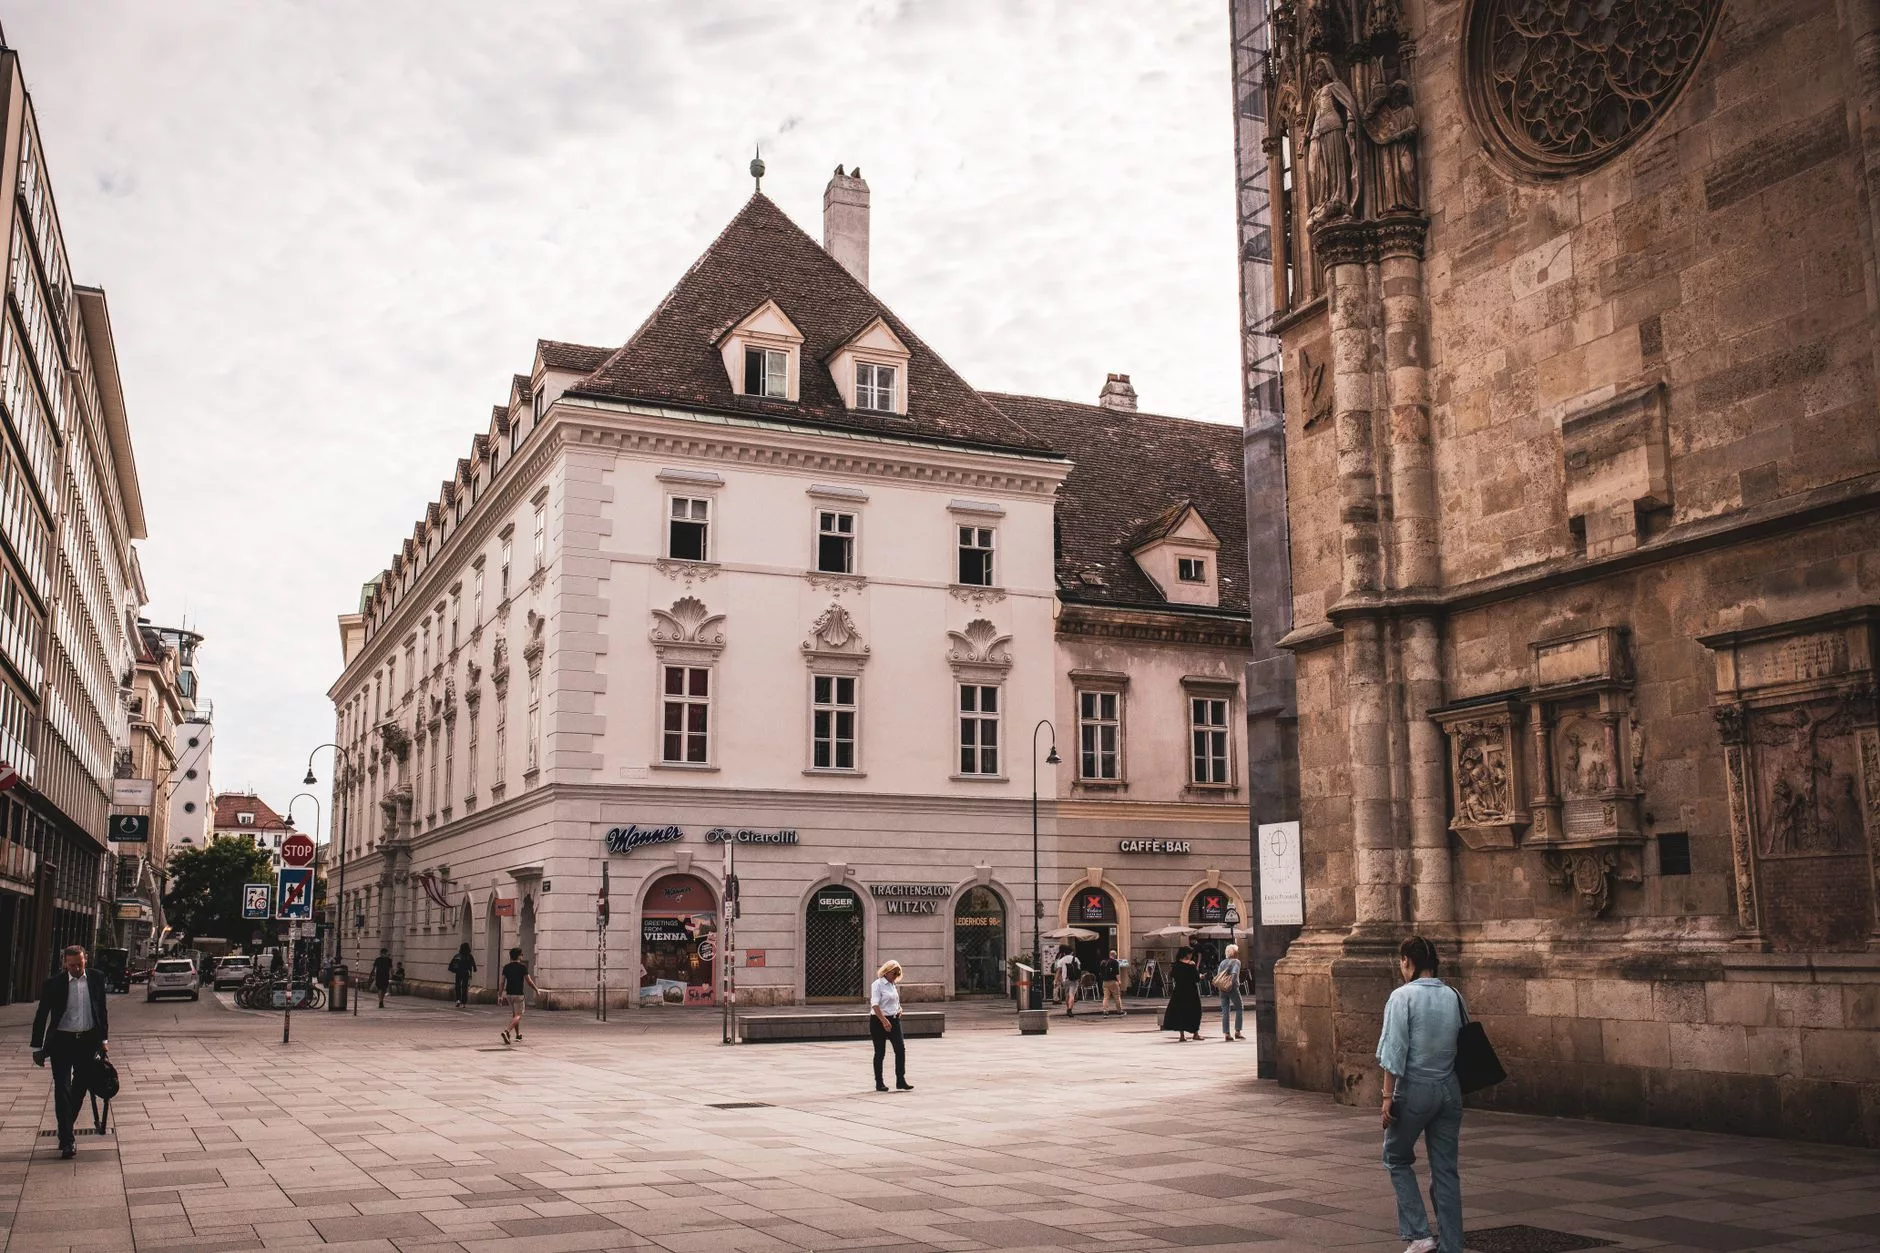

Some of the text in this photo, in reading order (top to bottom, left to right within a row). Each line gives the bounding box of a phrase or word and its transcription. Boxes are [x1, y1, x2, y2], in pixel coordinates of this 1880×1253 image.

[605, 825, 685, 854] Manner
[737, 829, 797, 844] Giarolli
[283, 844, 312, 857] STOP
[871, 885, 951, 896] TRACHTENSALON
[887, 901, 937, 913] WITZKY
[955, 917, 987, 926] LEDERHOSE
[644, 932, 688, 941] VIENNA
